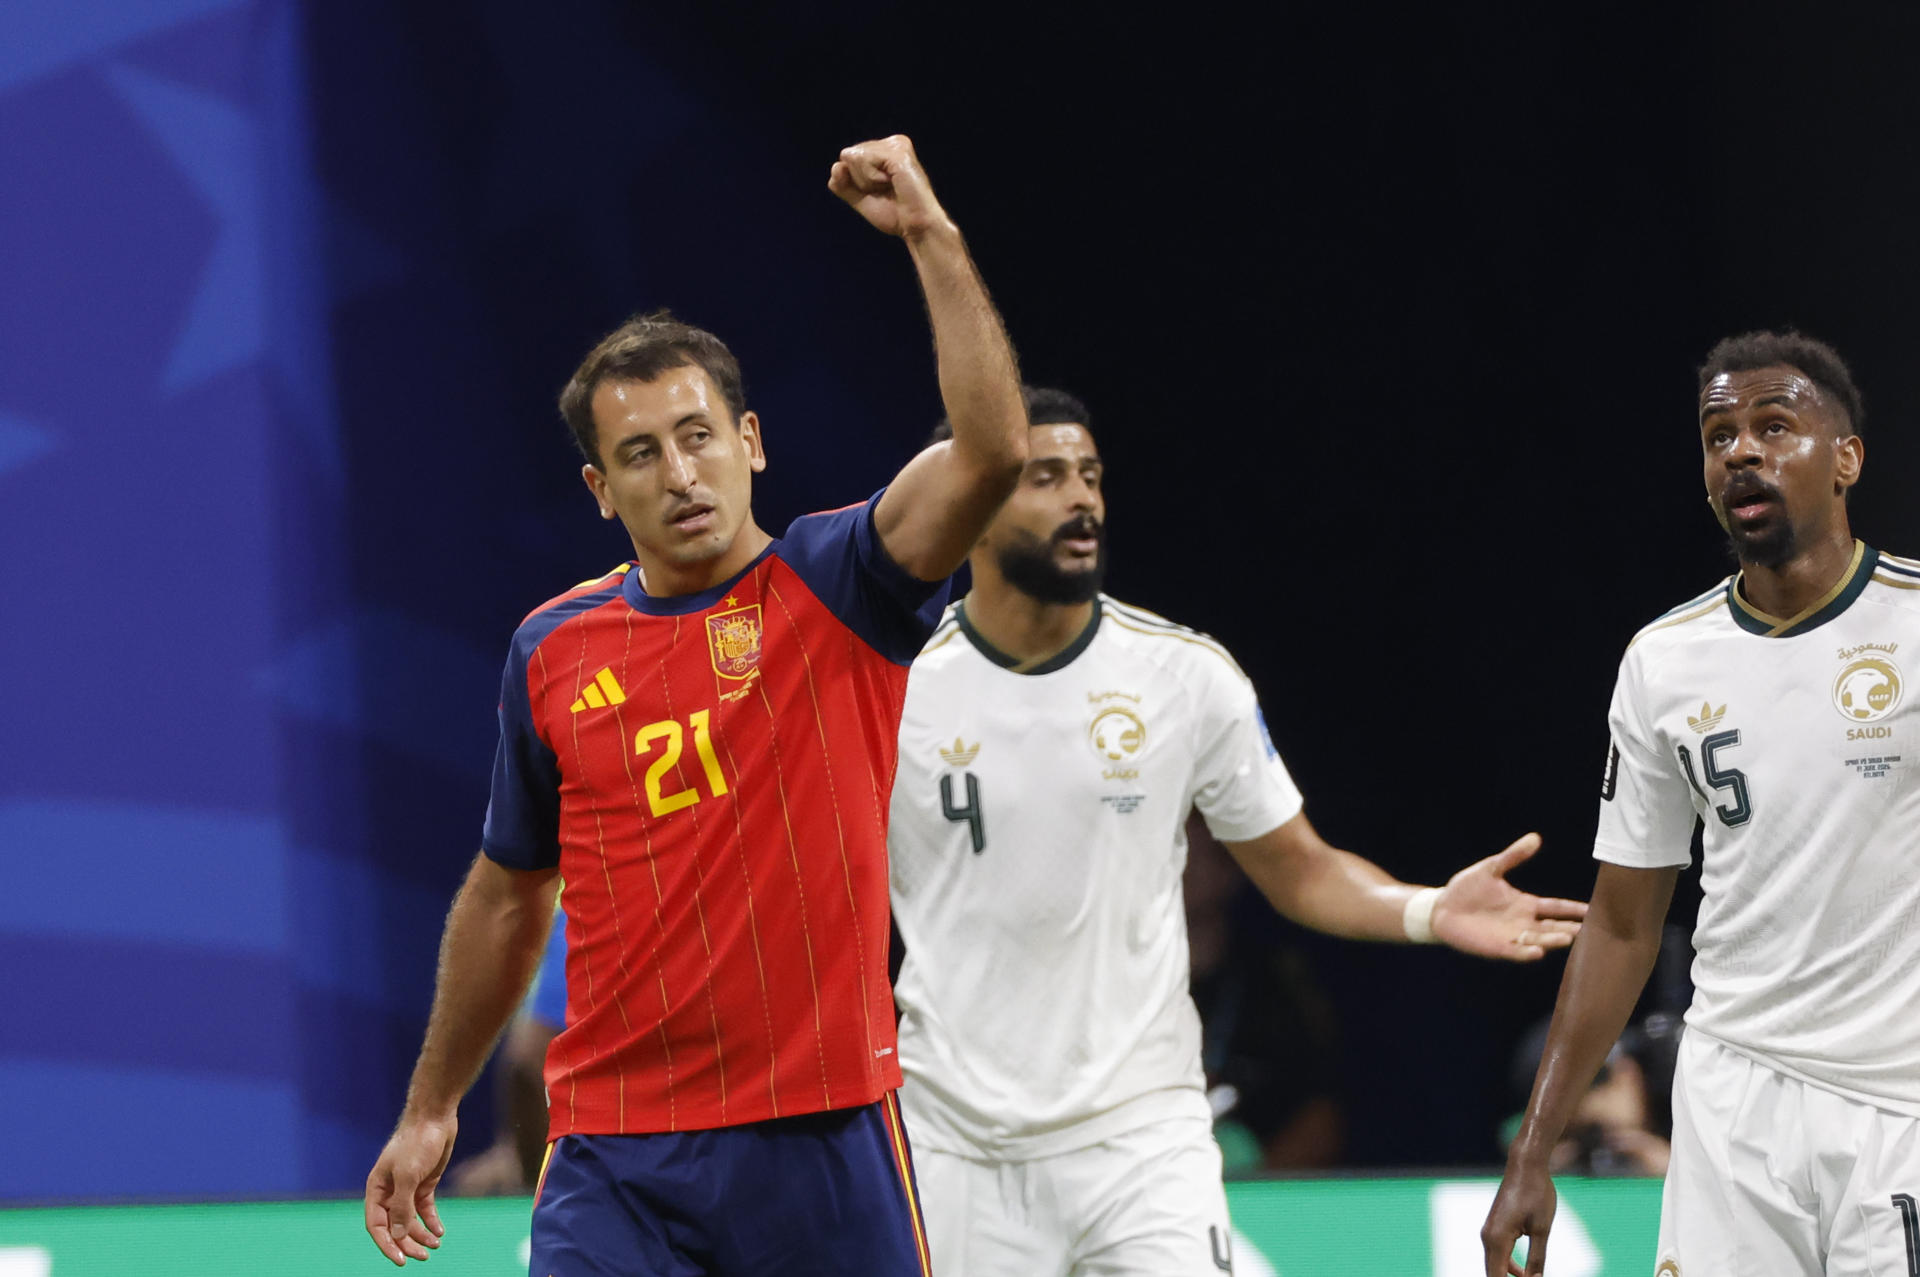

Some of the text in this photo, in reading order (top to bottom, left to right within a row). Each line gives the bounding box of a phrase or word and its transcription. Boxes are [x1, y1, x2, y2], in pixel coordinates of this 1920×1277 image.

[635, 708, 729, 818] 21
[1677, 729, 1754, 829] 15
[1846, 727, 1892, 741] SAUDI
[940, 771, 986, 854] 4
